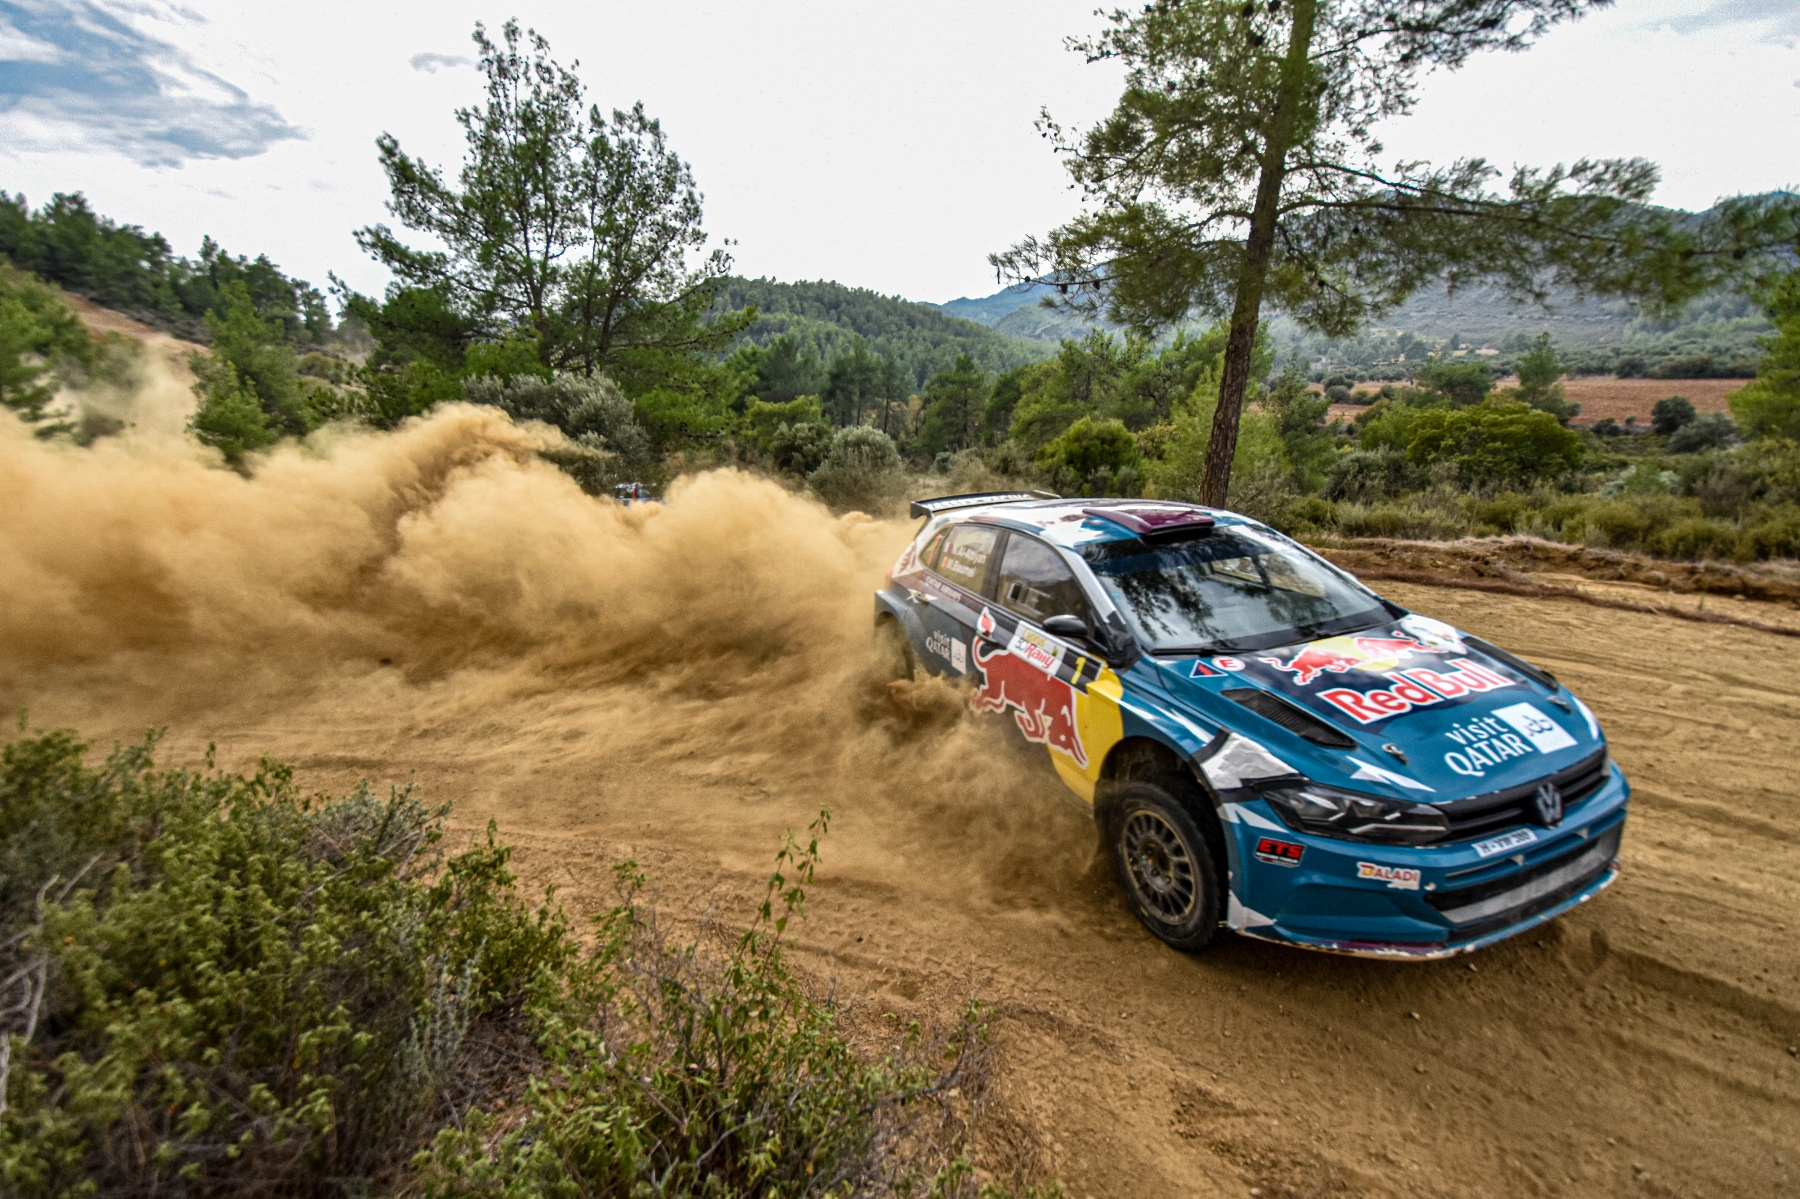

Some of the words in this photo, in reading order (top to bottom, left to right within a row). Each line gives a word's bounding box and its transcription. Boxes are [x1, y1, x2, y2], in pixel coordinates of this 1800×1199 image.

[926, 637, 951, 661] QATAR
[934, 630, 951, 648] visit
[1024, 643, 1055, 669] Rally
[1219, 660, 1237, 668] E
[1070, 656, 1086, 685] 1
[1316, 672, 1444, 724] Red
[1400, 658, 1516, 699] Bull
[1445, 717, 1508, 744] visit
[1444, 733, 1533, 777] QATAR
[1258, 838, 1304, 859] ETS
